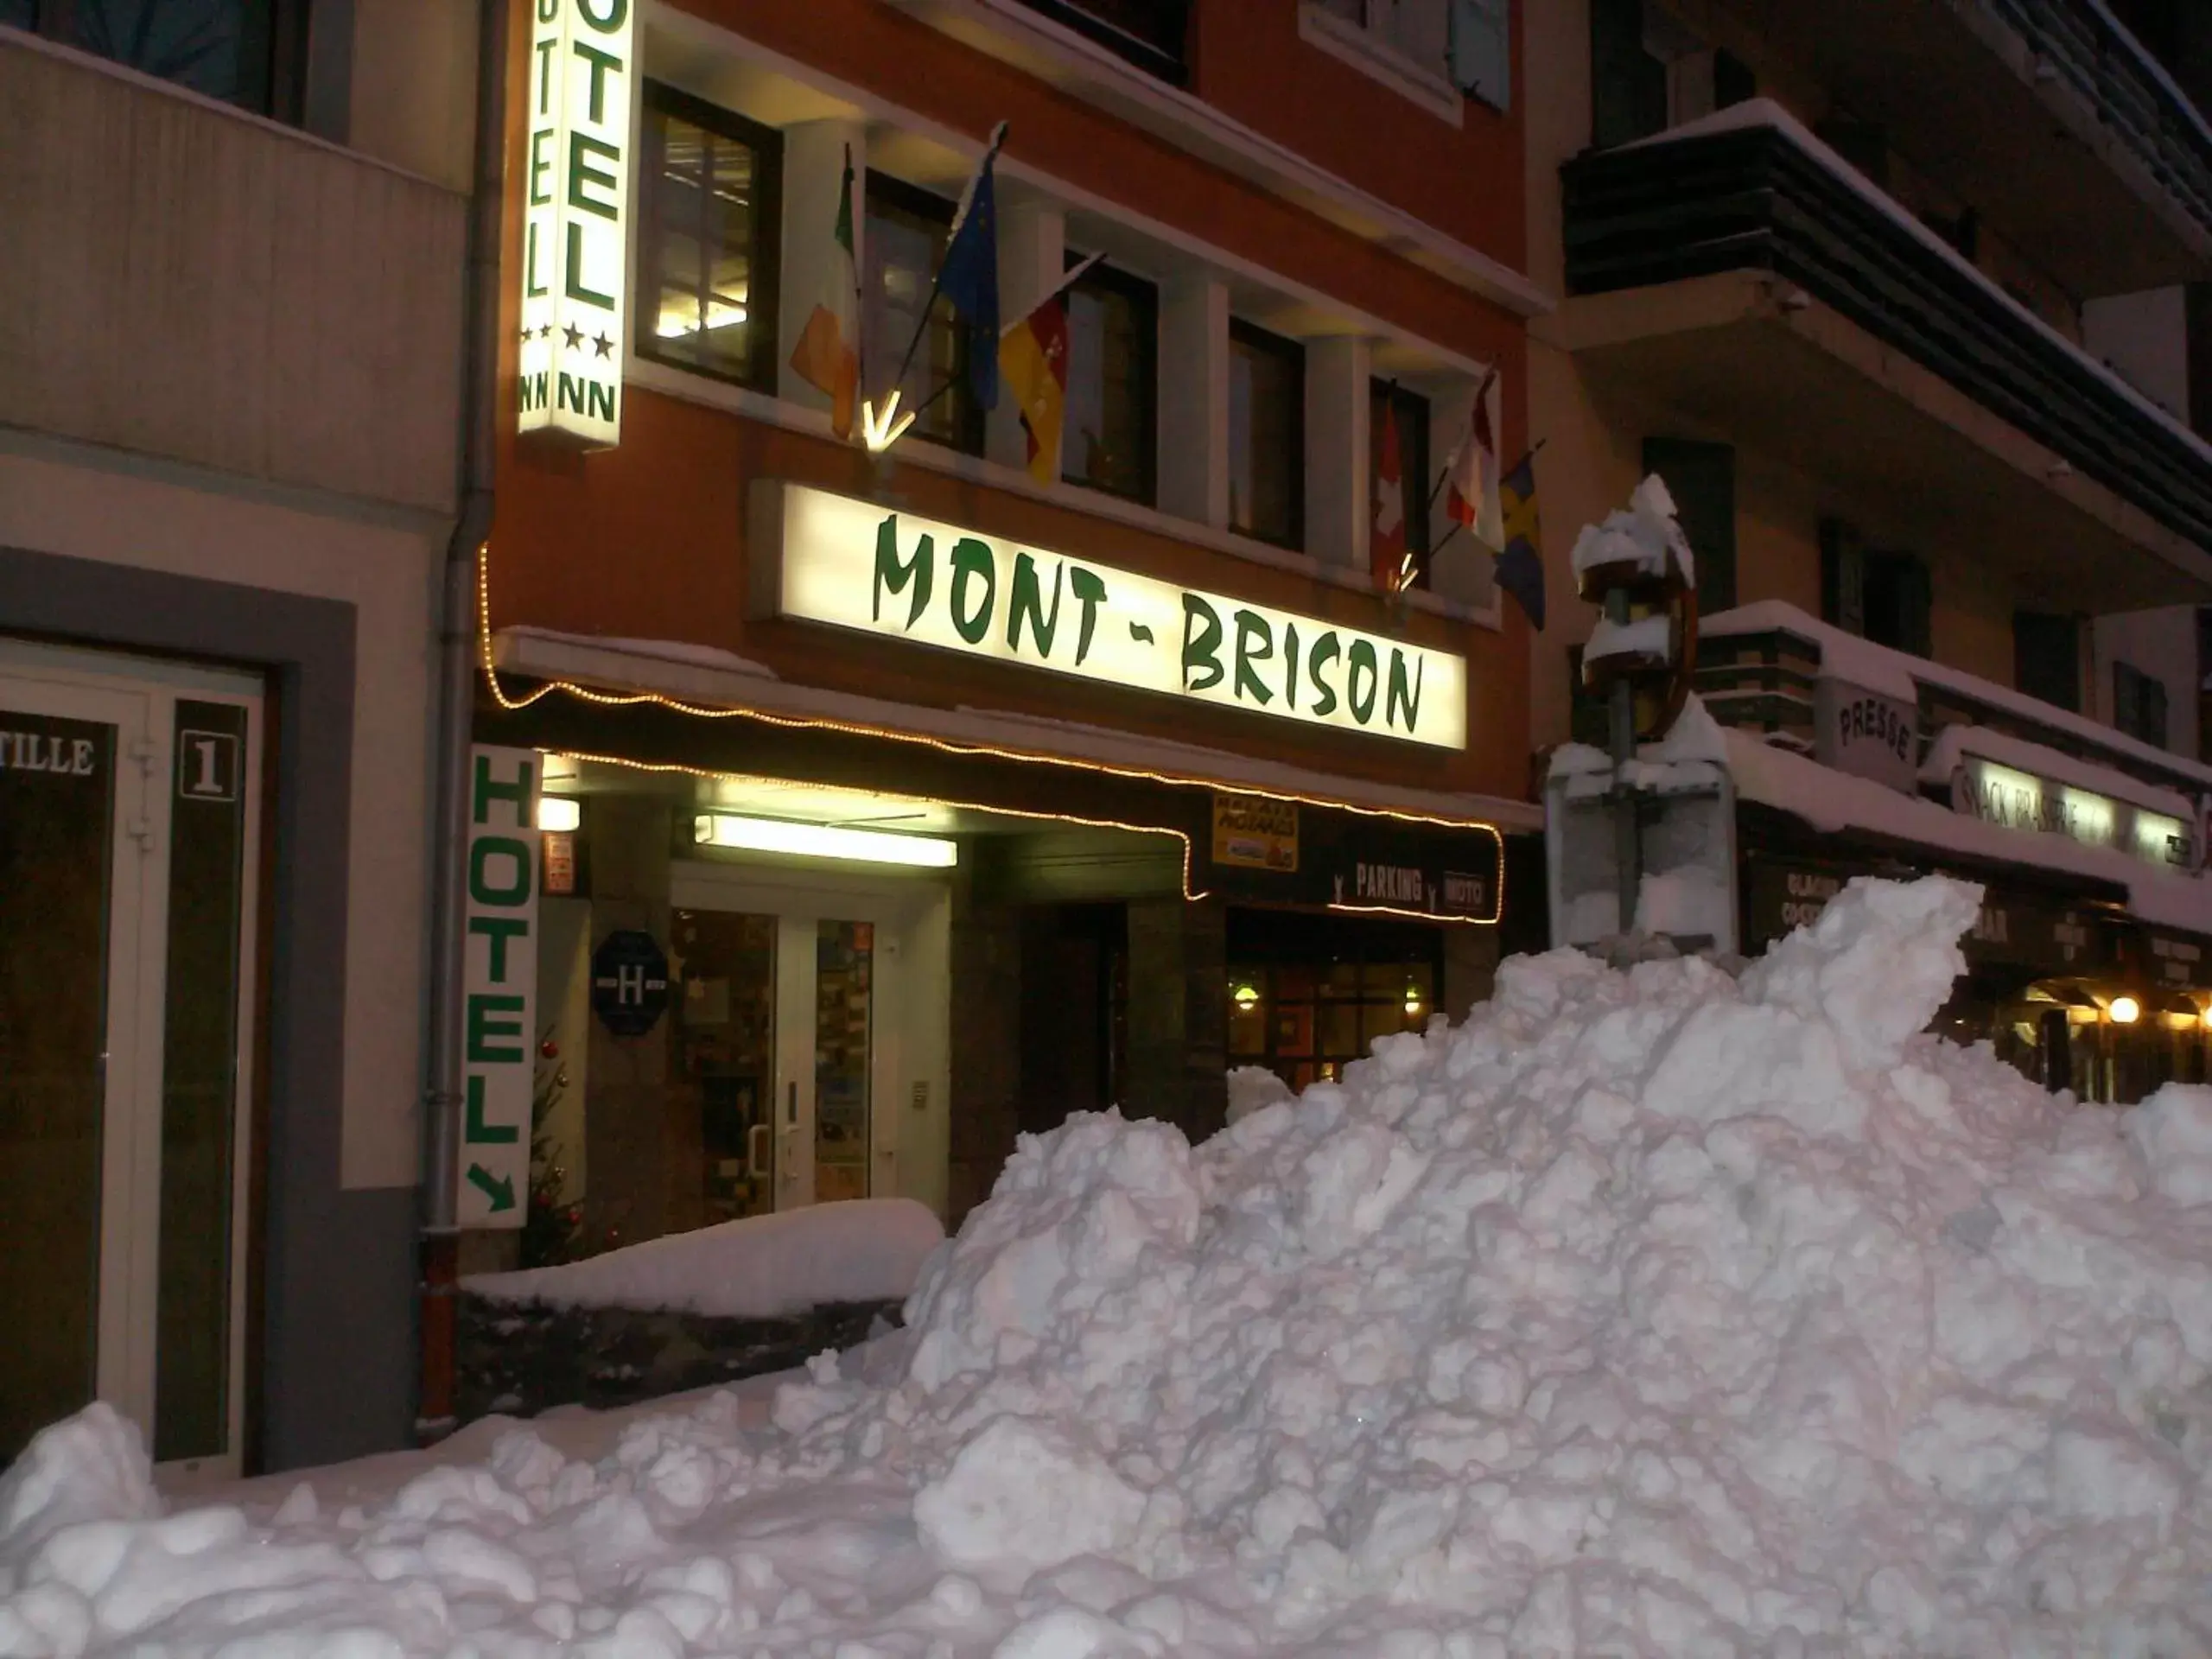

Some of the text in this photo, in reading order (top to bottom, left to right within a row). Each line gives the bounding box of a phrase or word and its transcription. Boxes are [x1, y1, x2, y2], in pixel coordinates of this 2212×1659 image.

[557, 371, 615, 423] NN
[1840, 697, 1910, 763] PRESSE
[193, 740, 223, 793] 1
[1356, 861, 1423, 903] PARKING
[466, 755, 533, 1144] HOTEL
[619, 964, 645, 1006] H
